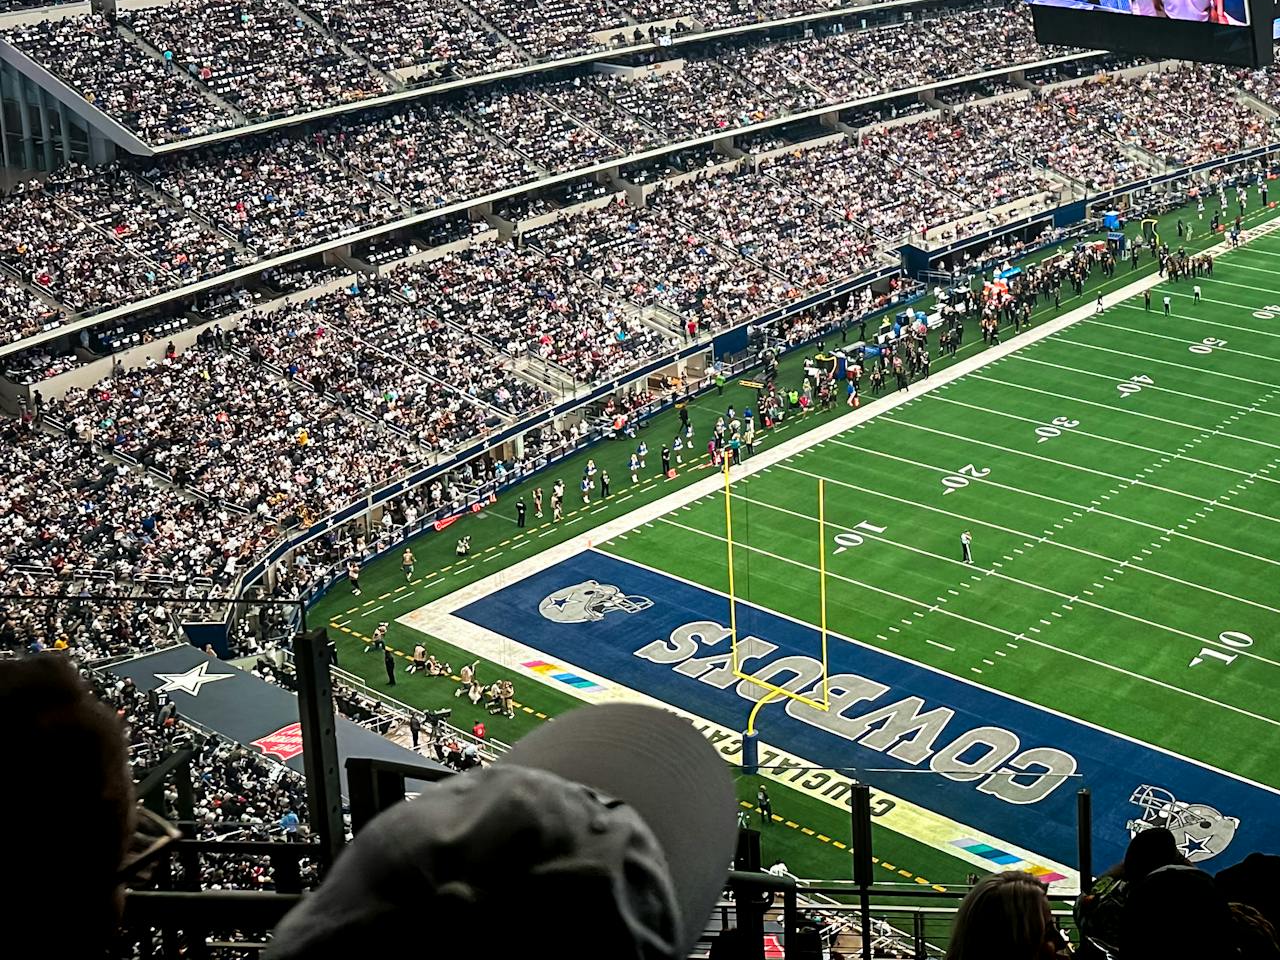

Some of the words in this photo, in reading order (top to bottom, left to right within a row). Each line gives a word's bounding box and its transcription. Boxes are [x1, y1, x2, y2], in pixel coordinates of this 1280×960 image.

[1188, 337, 1228, 354] 50
[1117, 374, 1154, 393] 40
[1035, 416, 1080, 437] 30
[941, 464, 991, 488] 20
[833, 520, 888, 547] 10
[1199, 631, 1254, 665] 10
[632, 620, 1078, 805] COWBOYS
